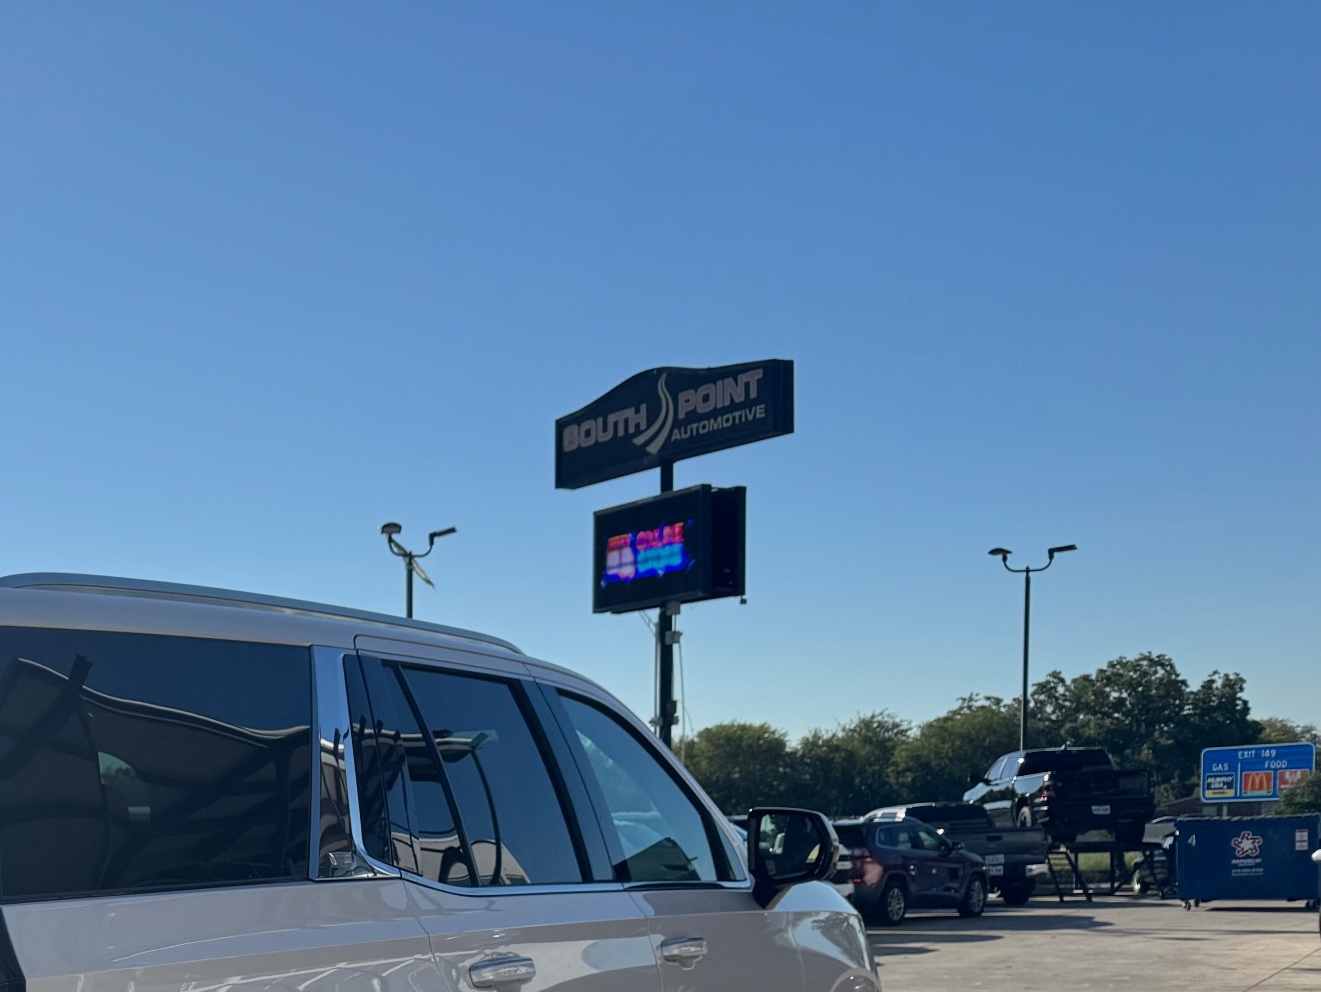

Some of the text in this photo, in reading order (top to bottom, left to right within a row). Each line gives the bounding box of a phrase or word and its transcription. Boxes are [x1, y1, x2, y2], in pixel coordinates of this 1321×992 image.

[562, 368, 763, 452] SOUTH POINT
[671, 404, 766, 442] AUTOMOTIVE
[1238, 749, 1276, 759] EXIT 149
[1212, 763, 1229, 771] GAS
[1264, 760, 1288, 769] FOOD
[1187, 834, 1196, 846] 4
